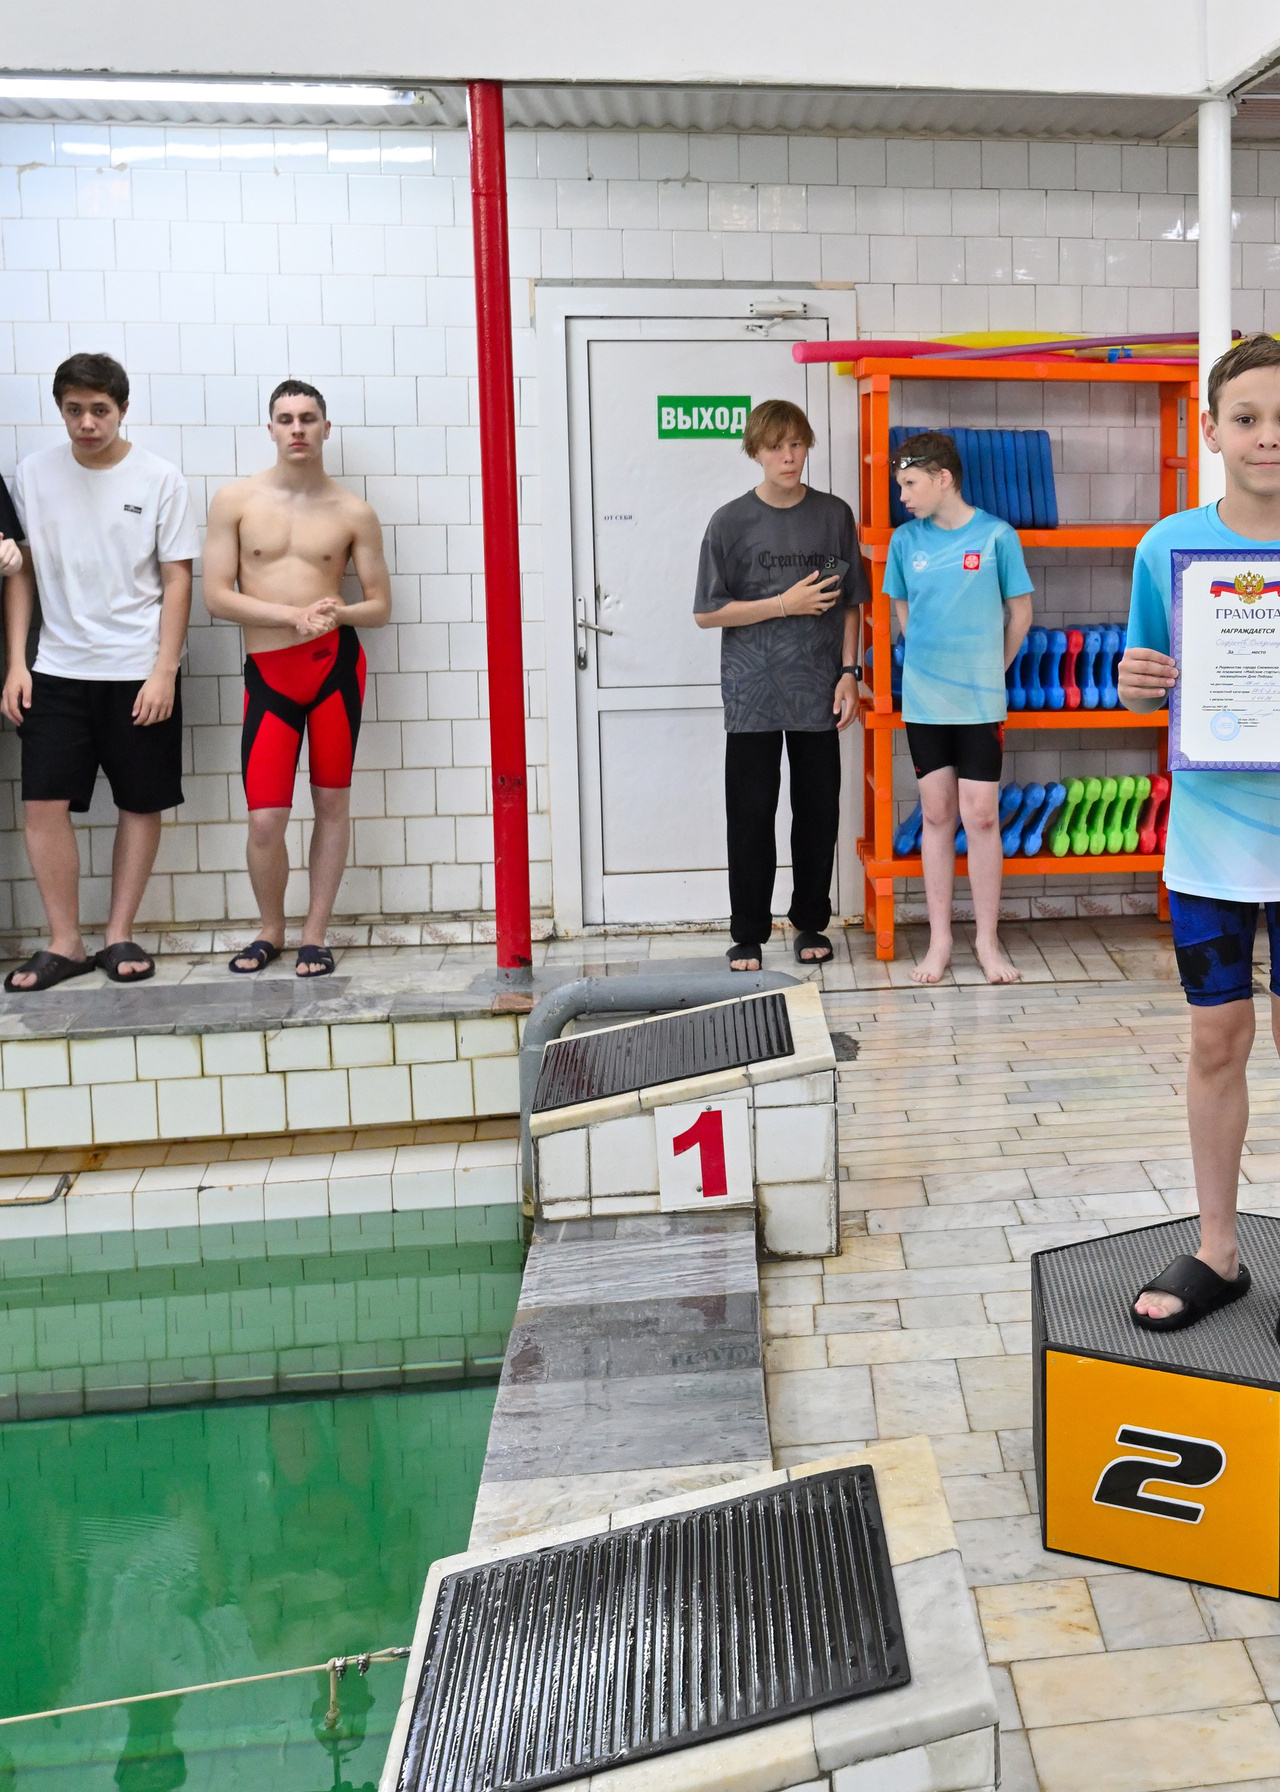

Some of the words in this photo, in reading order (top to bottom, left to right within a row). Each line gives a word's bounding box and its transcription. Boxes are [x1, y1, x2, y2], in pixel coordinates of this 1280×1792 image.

[661, 406, 747, 434] ВЫХОД
[759, 550, 826, 569] Creativity
[672, 1110, 728, 1198] 1
[1092, 1423, 1227, 1525] 2
